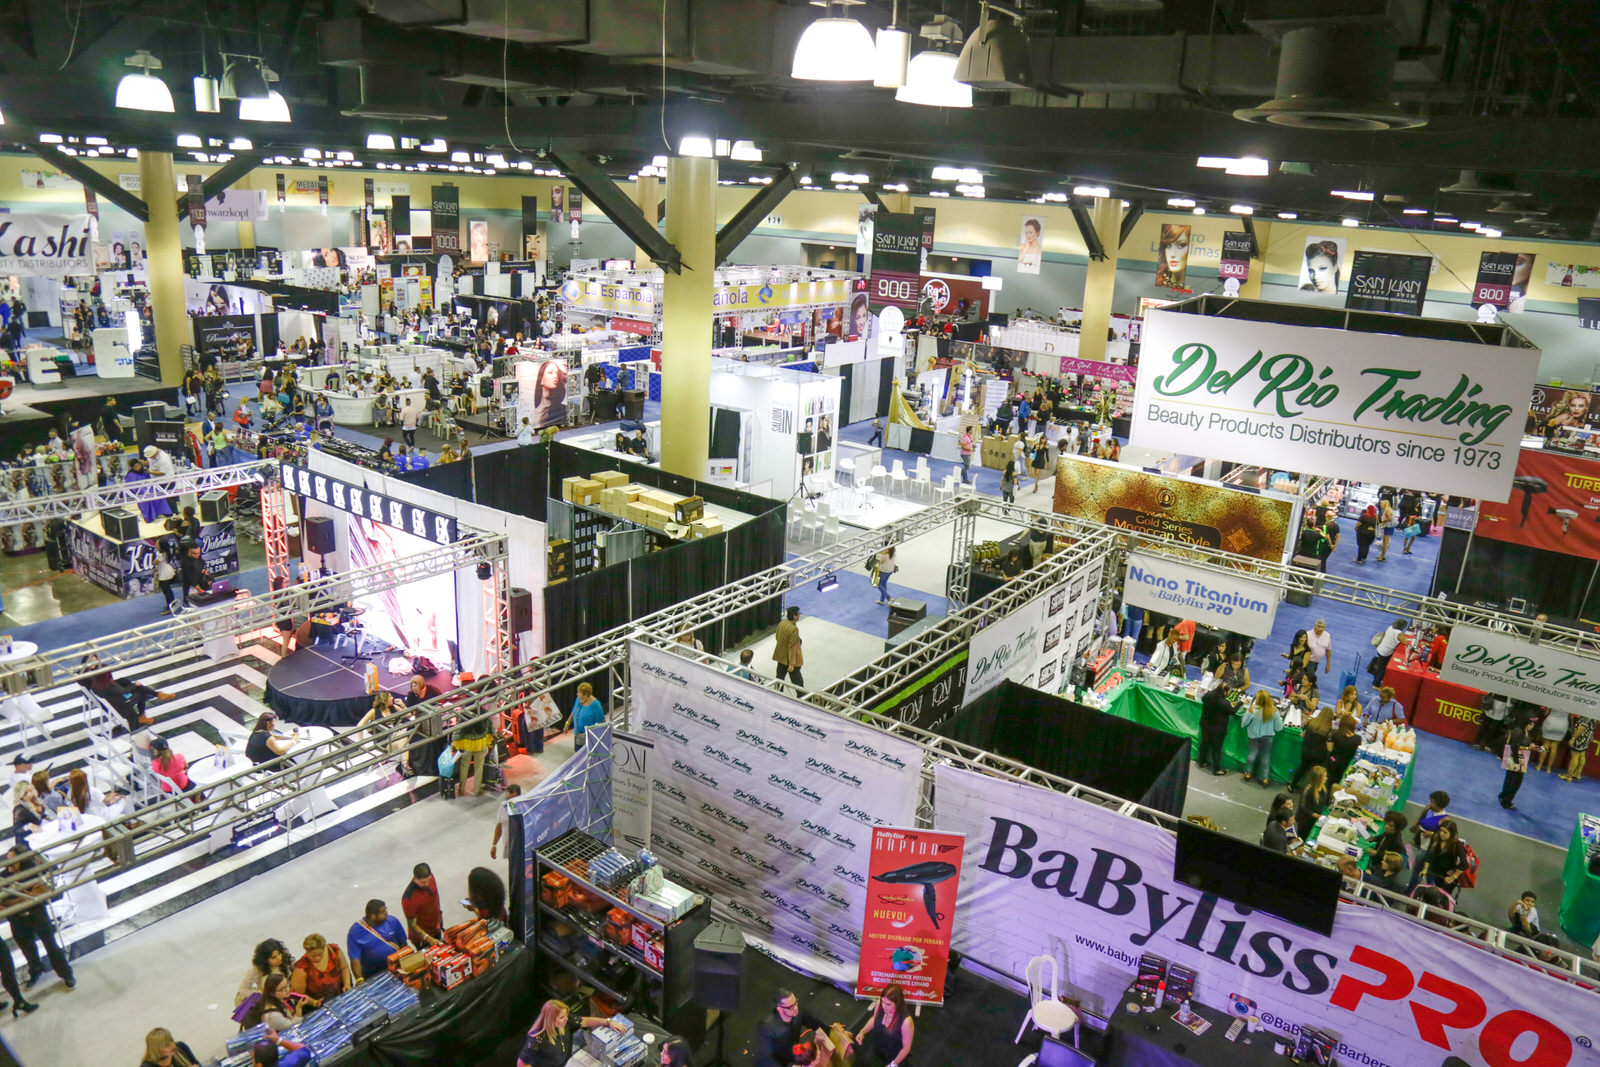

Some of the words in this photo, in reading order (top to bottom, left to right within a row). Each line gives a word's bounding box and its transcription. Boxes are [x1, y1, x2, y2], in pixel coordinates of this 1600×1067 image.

[435, 235, 457, 249] 1000
[876, 233, 895, 244] SAN
[896, 235, 918, 250] JUAN
[18, 258, 88, 269] DISTRIBUTORS
[1224, 264, 1244, 274] 900
[584, 283, 598, 296] La
[601, 284, 652, 303] Española
[713, 288, 748, 306] añola
[878, 279, 910, 299] 900
[1354, 275, 1385, 291] SAN
[1386, 278, 1421, 295] JUAN
[1480, 289, 1504, 300] 800
[1153, 343, 1262, 398] Del
[1253, 353, 1340, 419] Rio
[1353, 368, 1512, 446] Trading
[1147, 404, 1204, 432] Beauty
[1208, 412, 1285, 440] Products
[1290, 424, 1391, 457] Distributors
[1396, 438, 1446, 464] since
[1453, 446, 1502, 470] 1973
[1114, 519, 1175, 540] Moroccan
[1178, 532, 1210, 548] Style
[1136, 515, 1160, 528] Gold
[1162, 521, 1192, 534] Series
[1129, 566, 1178, 591] Nano
[1185, 580, 1268, 614] Titanium
[1149, 591, 1157, 599] by
[1157, 590, 1206, 611] BaByliss
[1207, 602, 1233, 616] PRO
[641, 662, 654, 671] Del
[668, 672, 688, 685] Trading
[971, 657, 995, 684] Del
[996, 645, 1010, 668] Rio
[1455, 645, 1510, 665] Del
[1507, 656, 1547, 680] Rio
[1451, 664, 1480, 677] Beauty
[1482, 670, 1519, 687] Products
[1522, 681, 1570, 700] Distributors
[1573, 693, 1597, 706] since
[704, 686, 718, 695] Del
[733, 696, 754, 711] Trading
[673, 703, 686, 712] Del
[700, 713, 720, 727] Trading
[772, 712, 787, 722] Del
[803, 723, 826, 738] Trading
[642, 720, 655, 729] Del
[669, 730, 688, 744] Trading
[736, 729, 751, 739] Del
[766, 740, 788, 756] Trading
[704, 745, 717, 755] Del
[731, 756, 752, 772] Trading
[845, 740, 862, 750] Del
[880, 752, 906, 768] Trading
[672, 760, 685, 770] Del
[698, 771, 718, 786] Trading
[806, 758, 822, 768] Del
[838, 769, 862, 785] Trading
[768, 774, 784, 784] Del
[799, 785, 821, 801] Trading
[734, 789, 748, 799] Del
[762, 800, 784, 816] Trading
[701, 803, 715, 813] Del
[728, 814, 749, 830] Trading
[802, 819, 817, 830] Del
[833, 831, 856, 848] Trading
[876, 838, 938, 856] RAPIDO
[873, 910, 907, 920] NUEVO!
